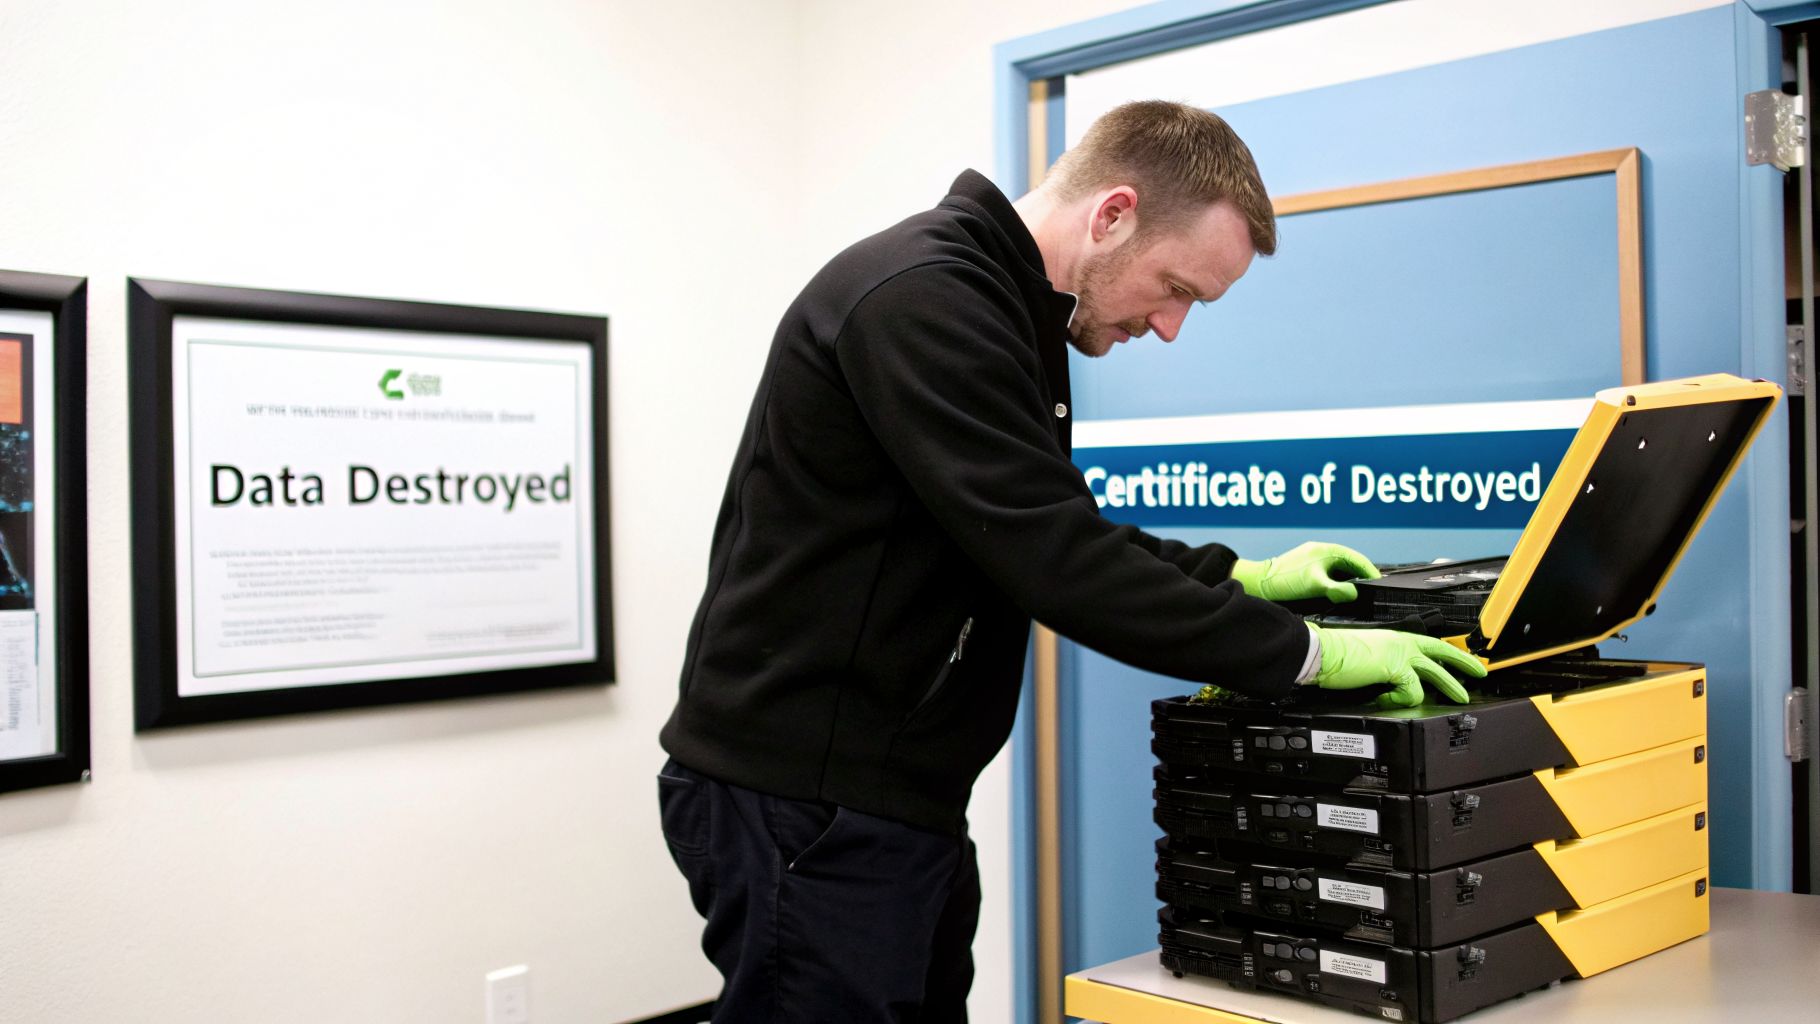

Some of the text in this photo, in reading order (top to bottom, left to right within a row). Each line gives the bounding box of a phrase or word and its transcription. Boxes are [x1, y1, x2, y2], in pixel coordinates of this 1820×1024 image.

[210, 463, 572, 512] Data Destroyed
[1300, 461, 1338, 504] of
[1351, 461, 1541, 511] Destroyed
